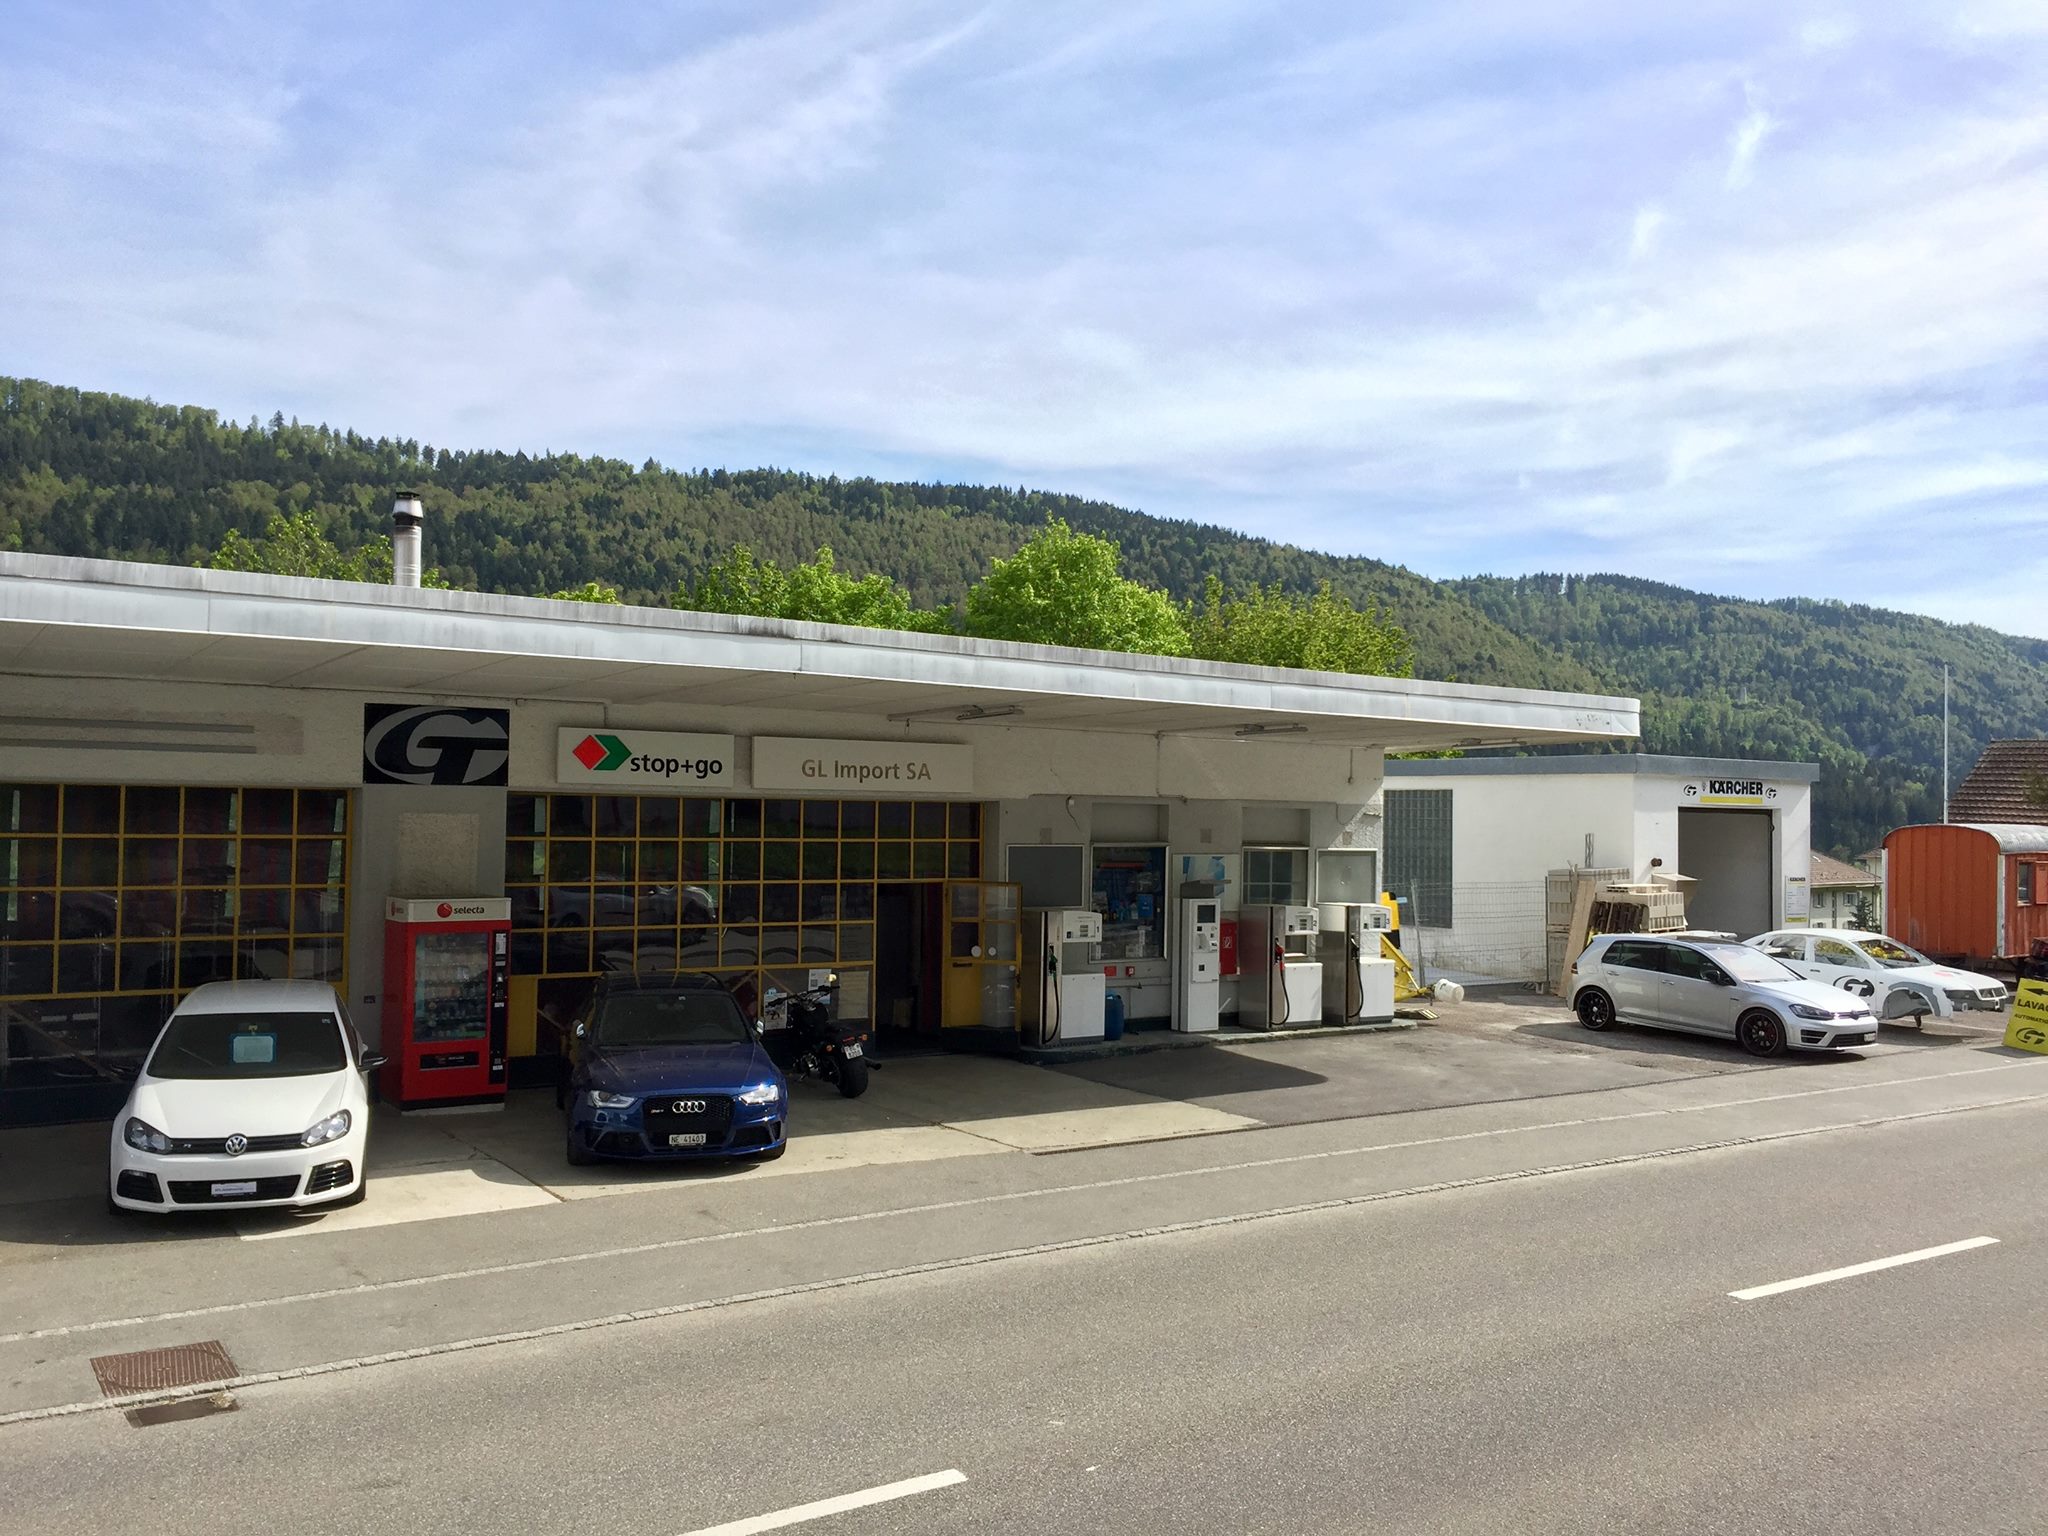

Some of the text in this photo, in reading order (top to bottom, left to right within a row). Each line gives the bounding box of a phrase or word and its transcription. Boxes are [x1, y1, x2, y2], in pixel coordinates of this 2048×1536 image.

[630, 754, 723, 779] stop+go
[801, 759, 932, 783] GL Import SA
[1709, 780, 1763, 795] KÄRCHER
[453, 906, 485, 914] selecta
[671, 1135, 680, 1144] NE
